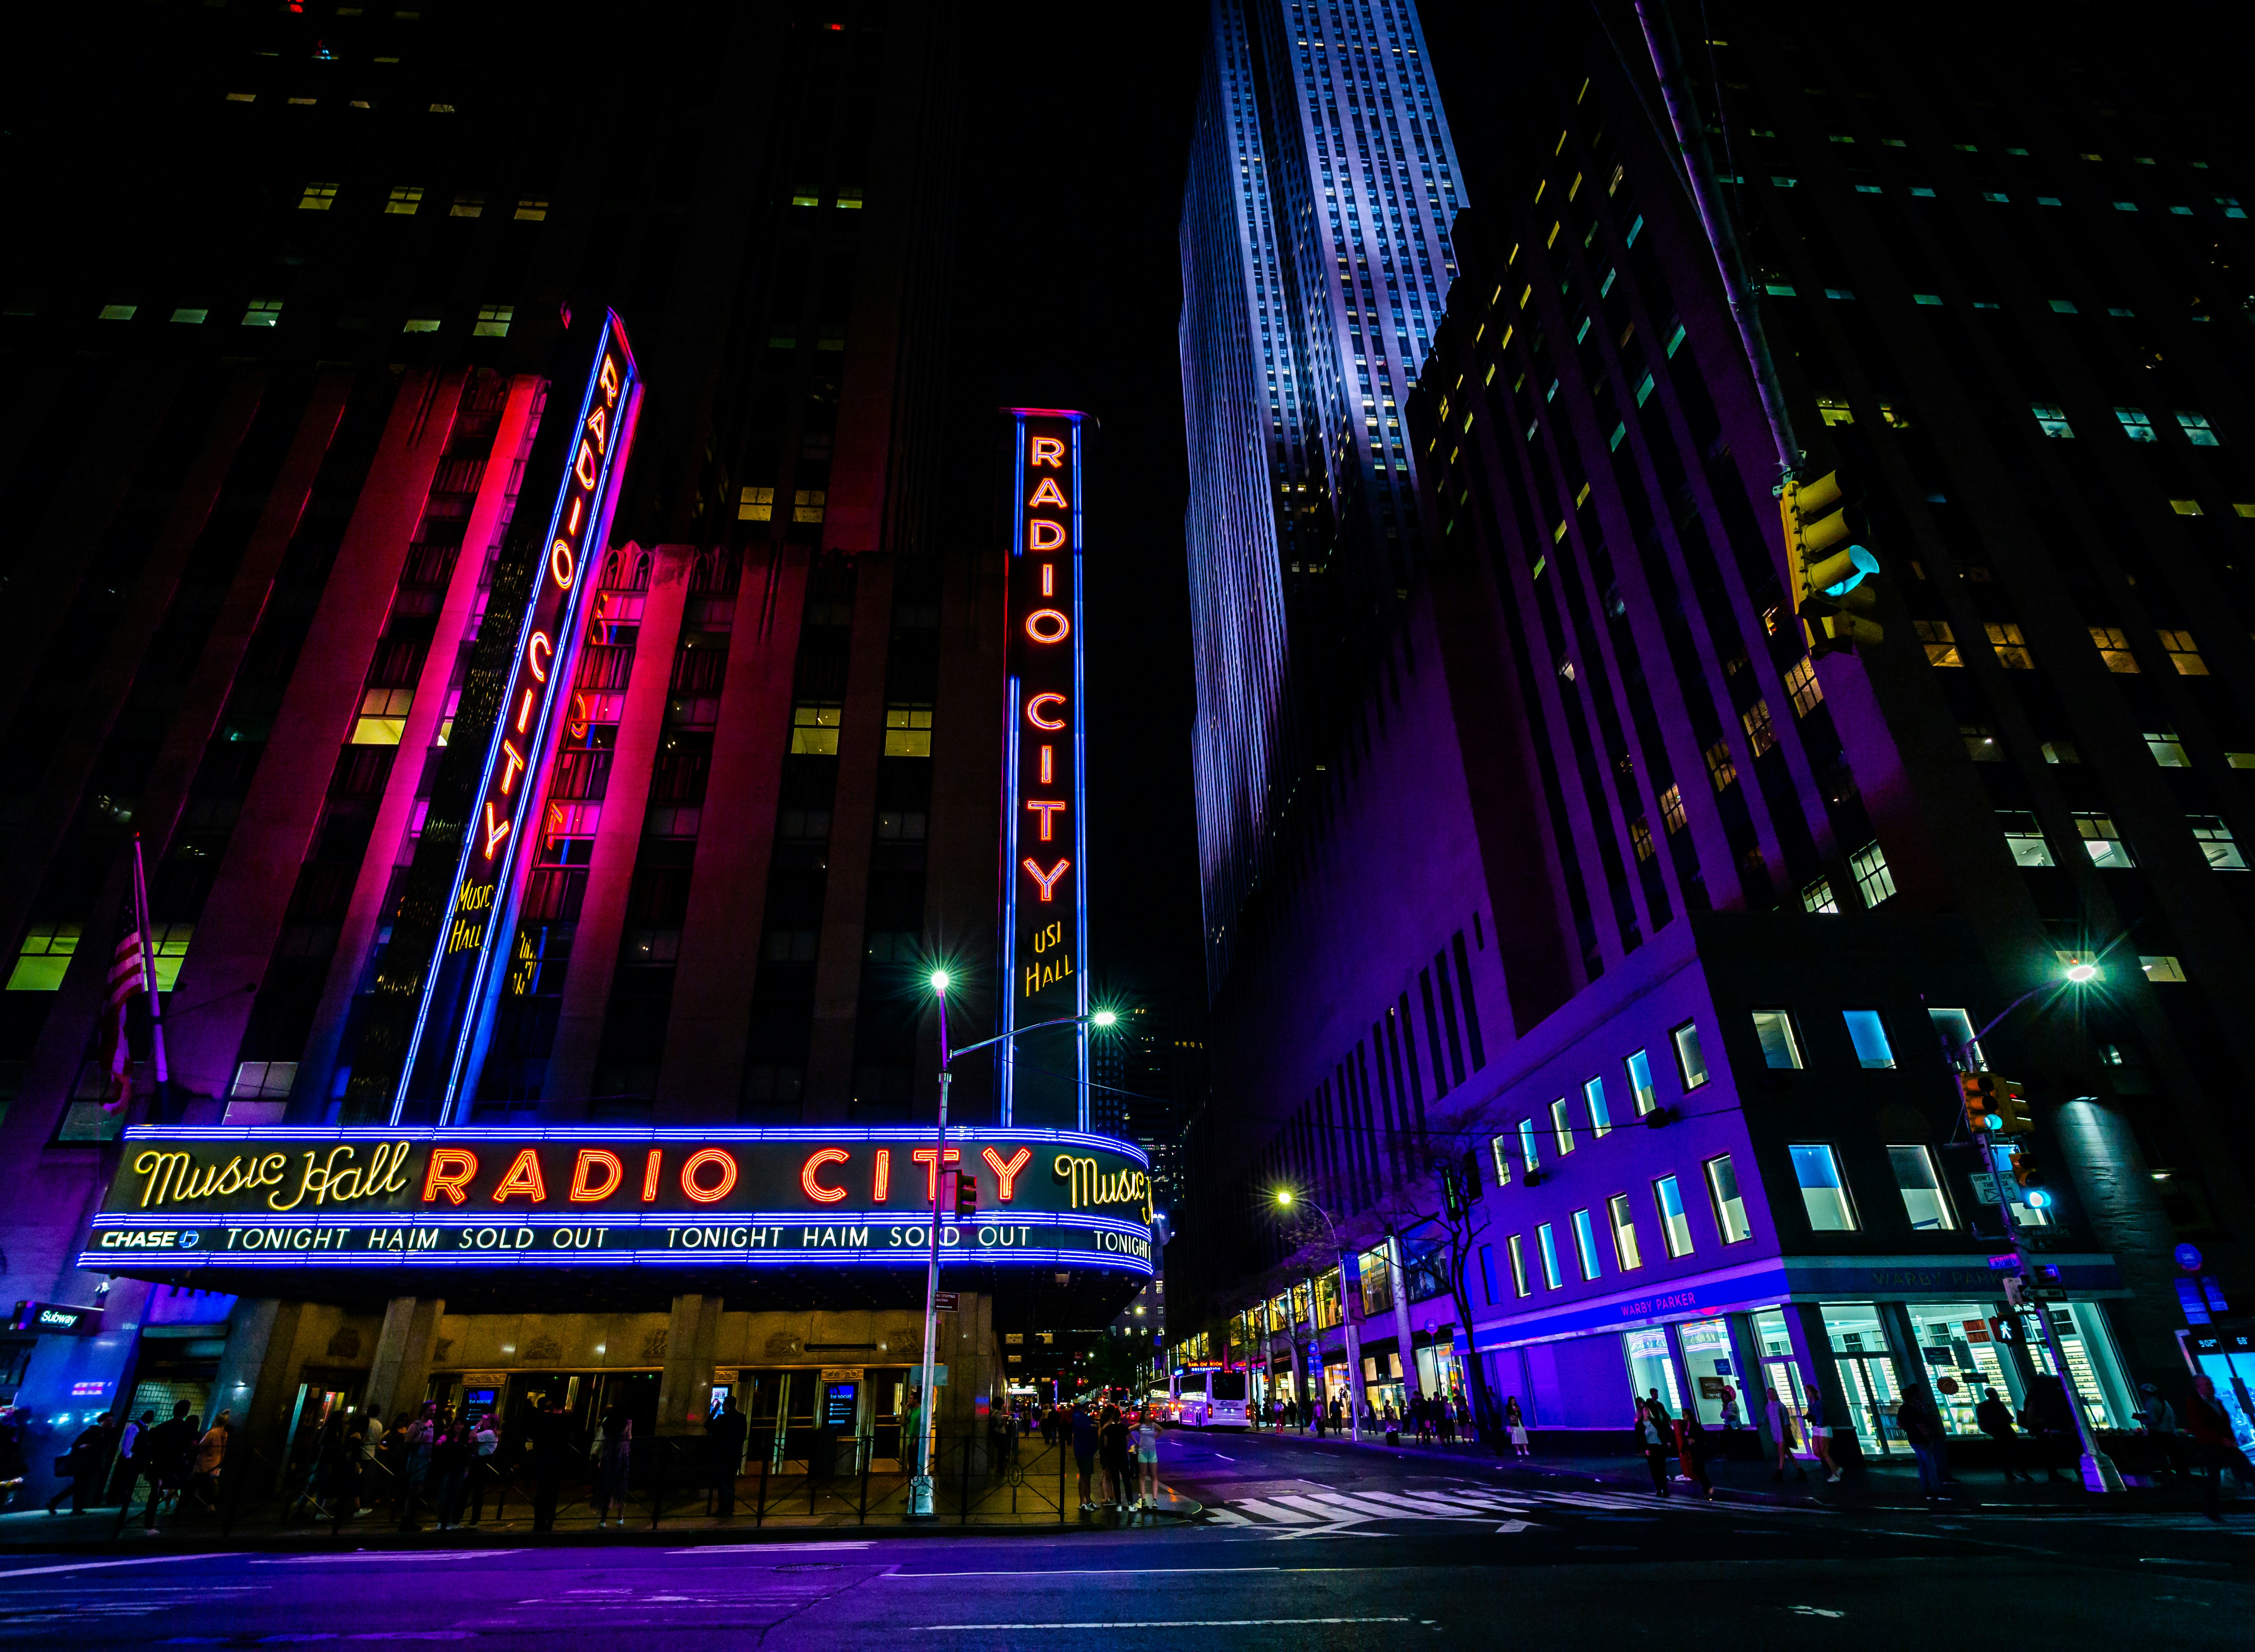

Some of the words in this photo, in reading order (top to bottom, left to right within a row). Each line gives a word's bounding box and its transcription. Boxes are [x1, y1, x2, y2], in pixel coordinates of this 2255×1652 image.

[552, 355, 618, 589] RADIO
[1026, 437, 1069, 643] RADIO
[485, 632, 551, 860] CITY
[1024, 692, 1070, 901] CITY
[449, 919, 481, 954] HALL
[1025, 955, 1073, 998] HALL
[268, 1141, 410, 1211] Hall
[422, 1147, 738, 1205] RADIO
[803, 1146, 1032, 1202] CITY
[101, 1231, 178, 1248] CHASE
[227, 1228, 350, 1250] TONIGHT
[368, 1228, 439, 1249] HAIM
[459, 1227, 534, 1249] SOLD
[553, 1227, 610, 1249] OUT
[667, 1227, 784, 1248] TONIGHT
[803, 1226, 868, 1248] HAIM
[978, 1226, 1031, 1246] OUT
[1094, 1230, 1149, 1259] TONIGHT
[40, 1310, 78, 1327] Subway
[1620, 1300, 1652, 1316] WARBY
[1656, 1292, 1696, 1310] PARKER
